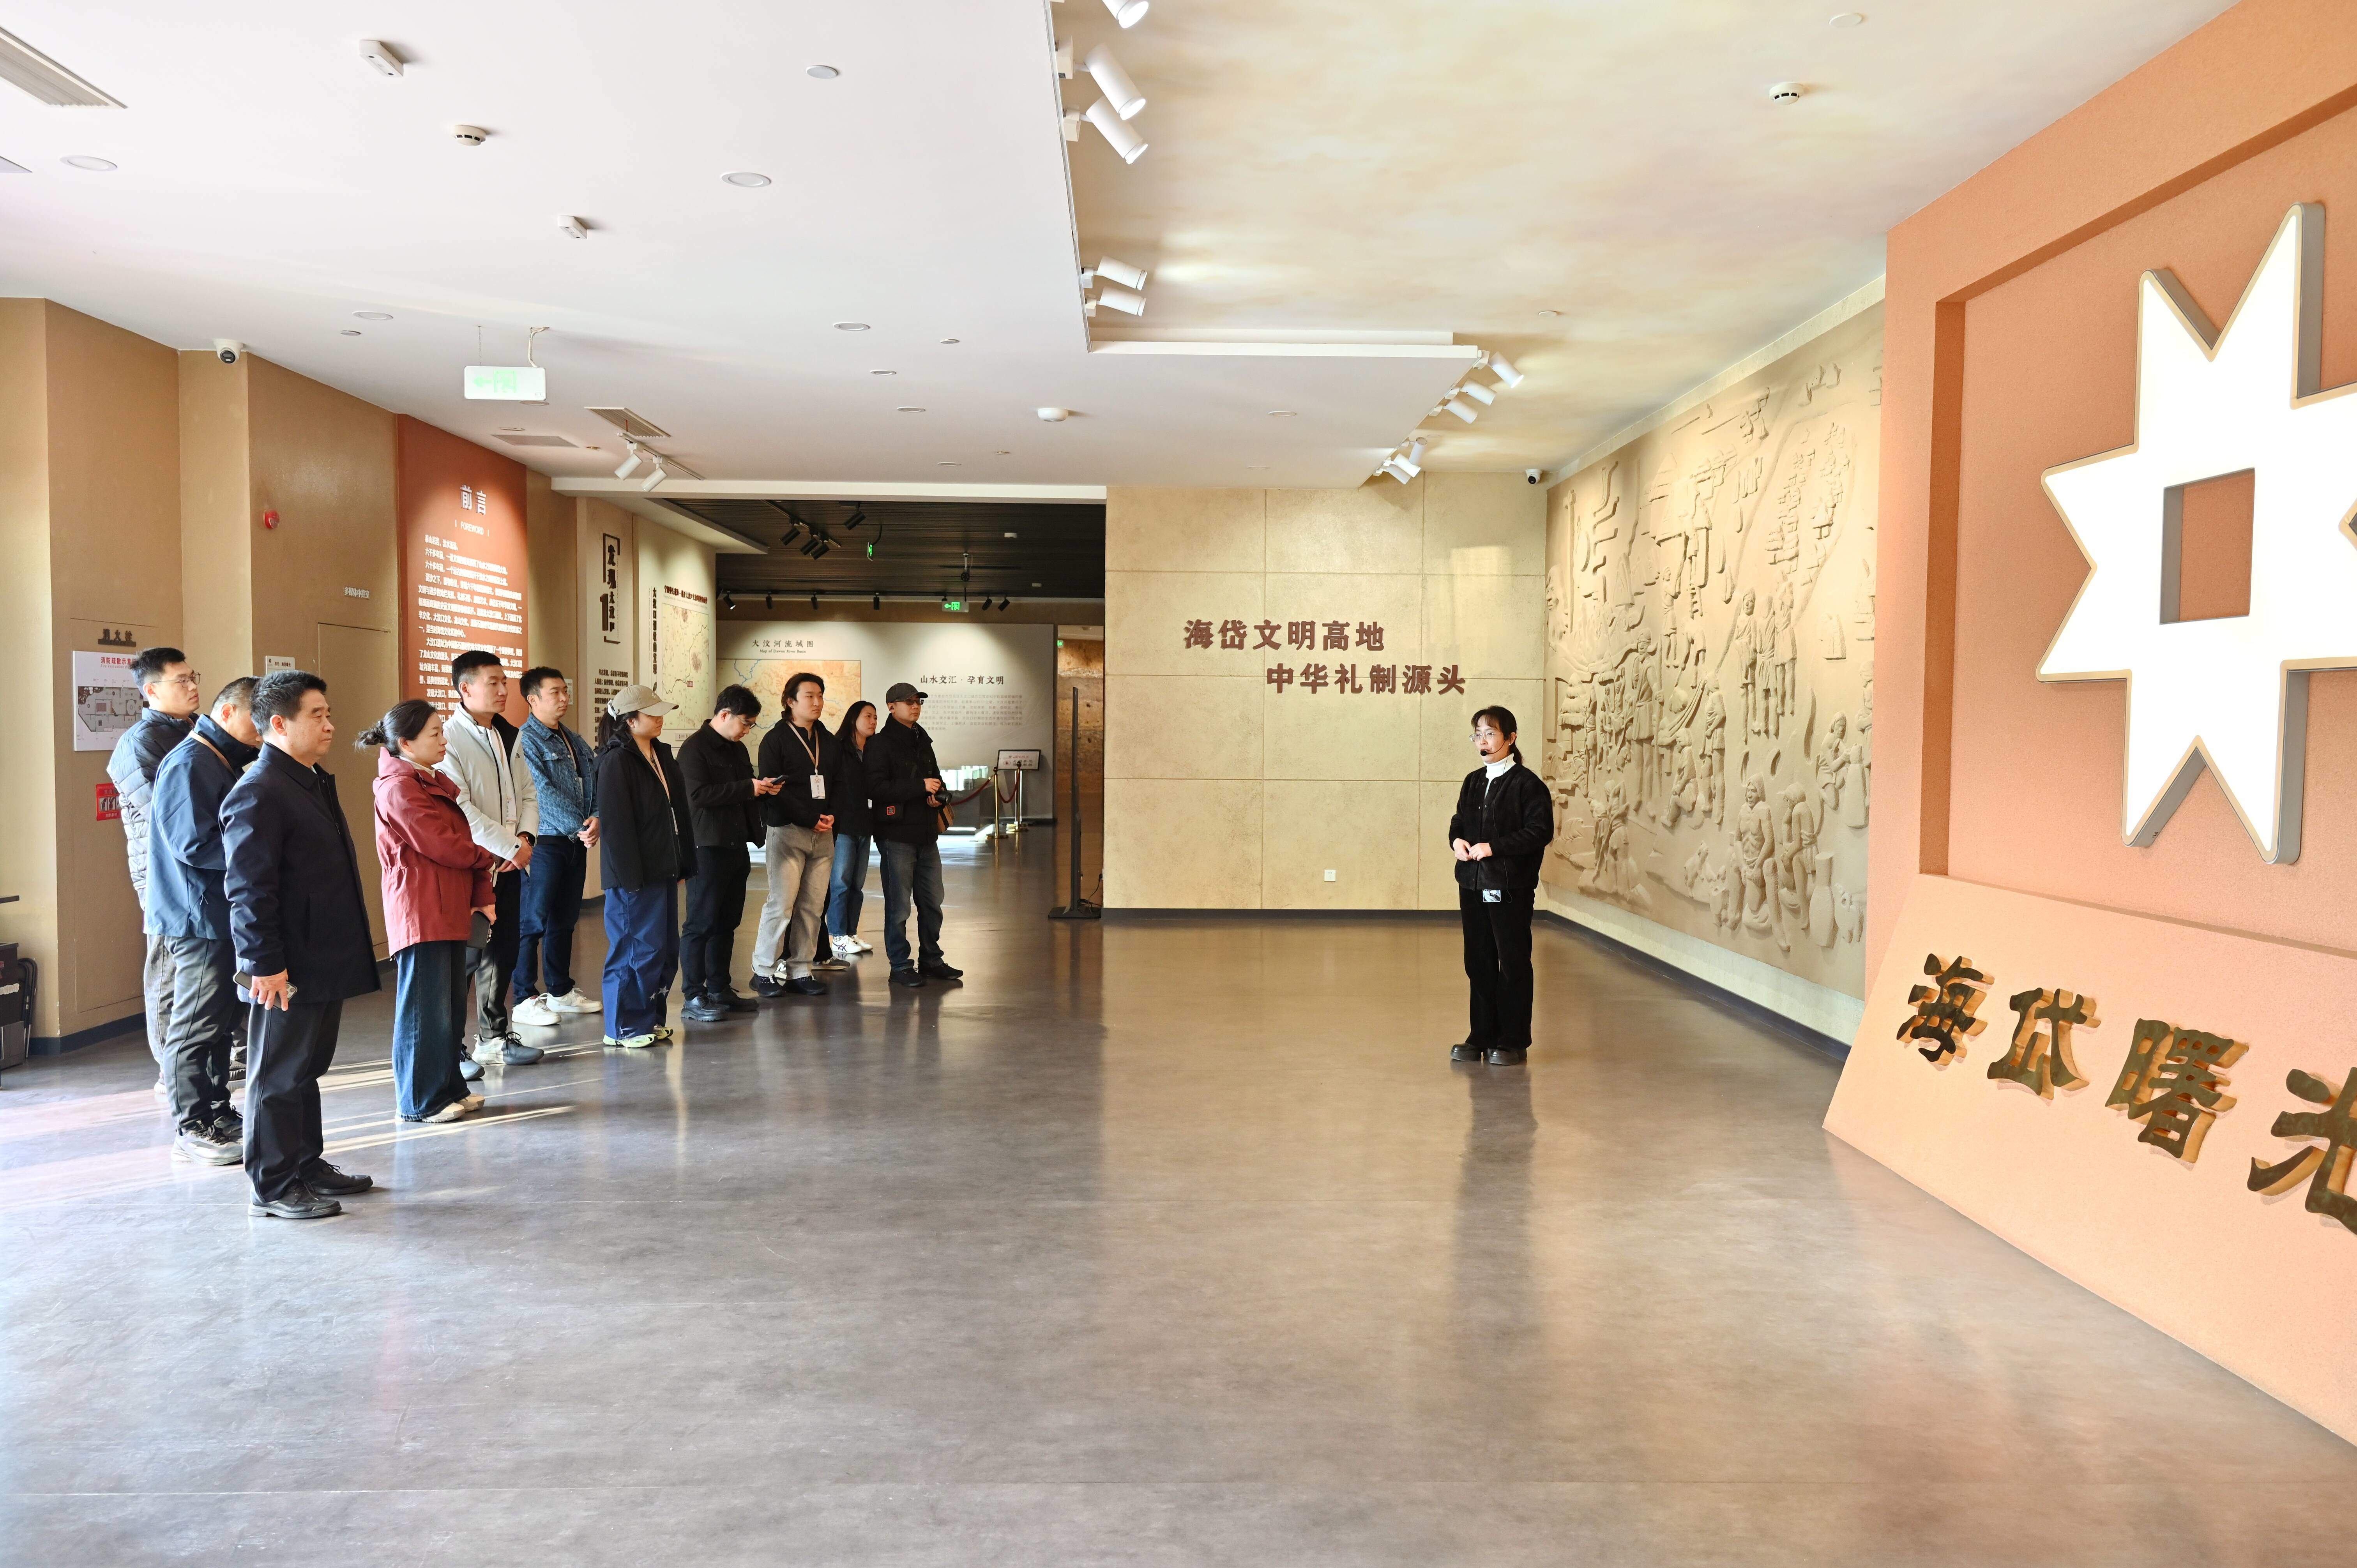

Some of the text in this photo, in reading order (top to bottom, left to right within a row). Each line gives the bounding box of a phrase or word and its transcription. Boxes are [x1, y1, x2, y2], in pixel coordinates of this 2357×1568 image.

[460, 485, 486, 515] 前言
[460, 521, 484, 535] FOREWORD
[345, 586, 370, 599] 多媒体中控室
[600, 593, 608, 631] 1
[752, 639, 813, 648] 大汶河流域图
[1184, 619, 1384, 651] 海岱文明高地
[1266, 663, 1466, 696] 中华礼制源头
